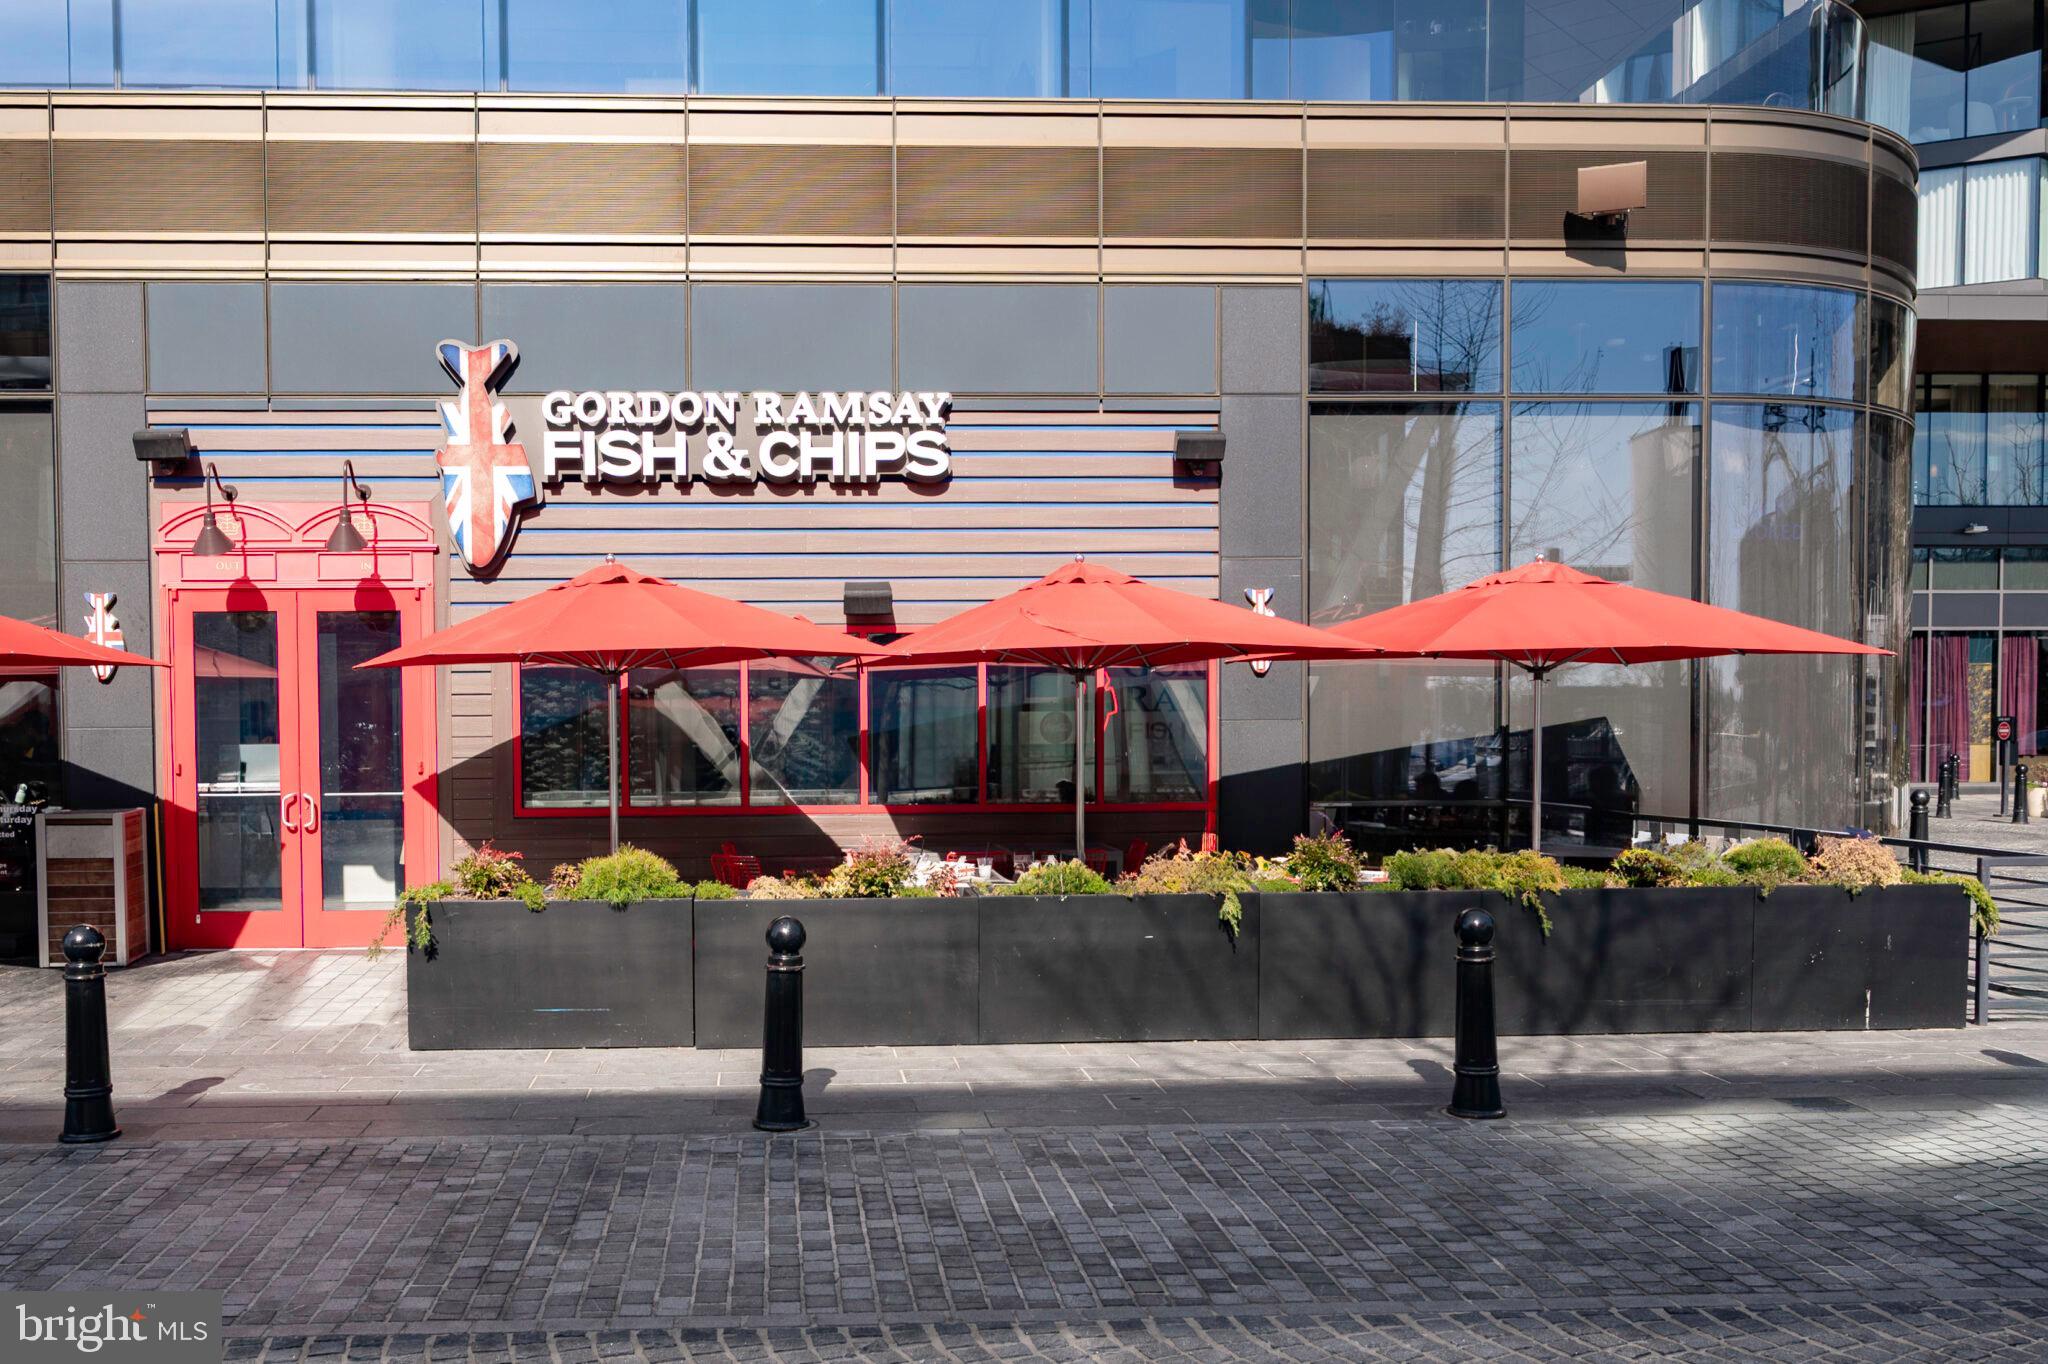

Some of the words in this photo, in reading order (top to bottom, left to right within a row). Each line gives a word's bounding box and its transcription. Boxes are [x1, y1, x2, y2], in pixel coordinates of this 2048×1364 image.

[542, 391, 739, 424] GORDON
[753, 391, 950, 424] RAMSAY
[543, 430, 687, 478] FISH
[702, 430, 751, 478] &
[759, 430, 951, 478] CHIPS
[215, 561, 241, 570] OUT
[360, 561, 373, 570] IN
